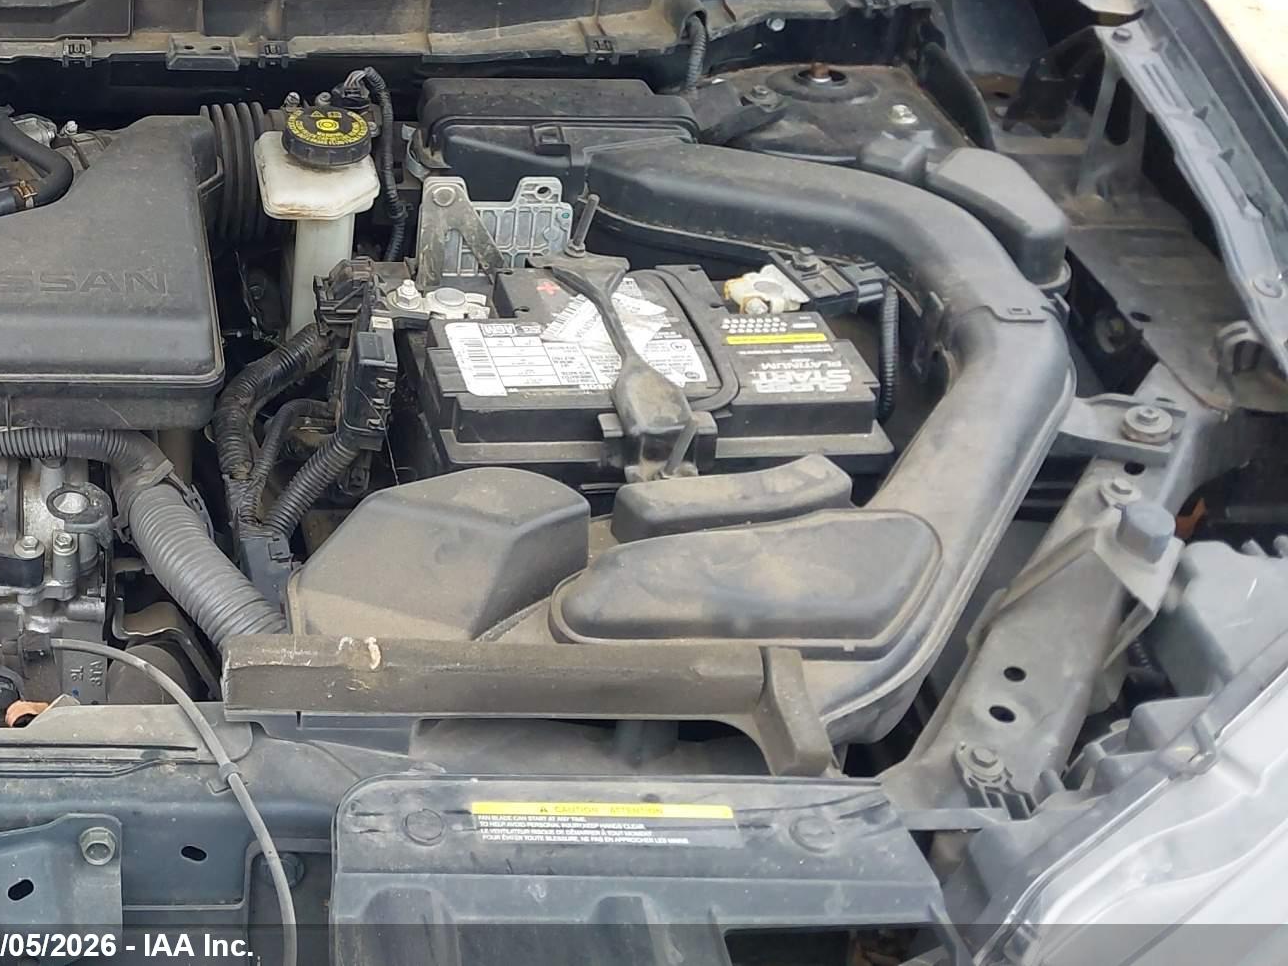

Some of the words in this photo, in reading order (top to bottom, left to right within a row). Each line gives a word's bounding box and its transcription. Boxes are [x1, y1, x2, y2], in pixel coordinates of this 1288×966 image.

[760, 360, 842, 370] PLATINUM
[752, 369, 852, 384] START
[755, 383, 847, 394] SUPER
